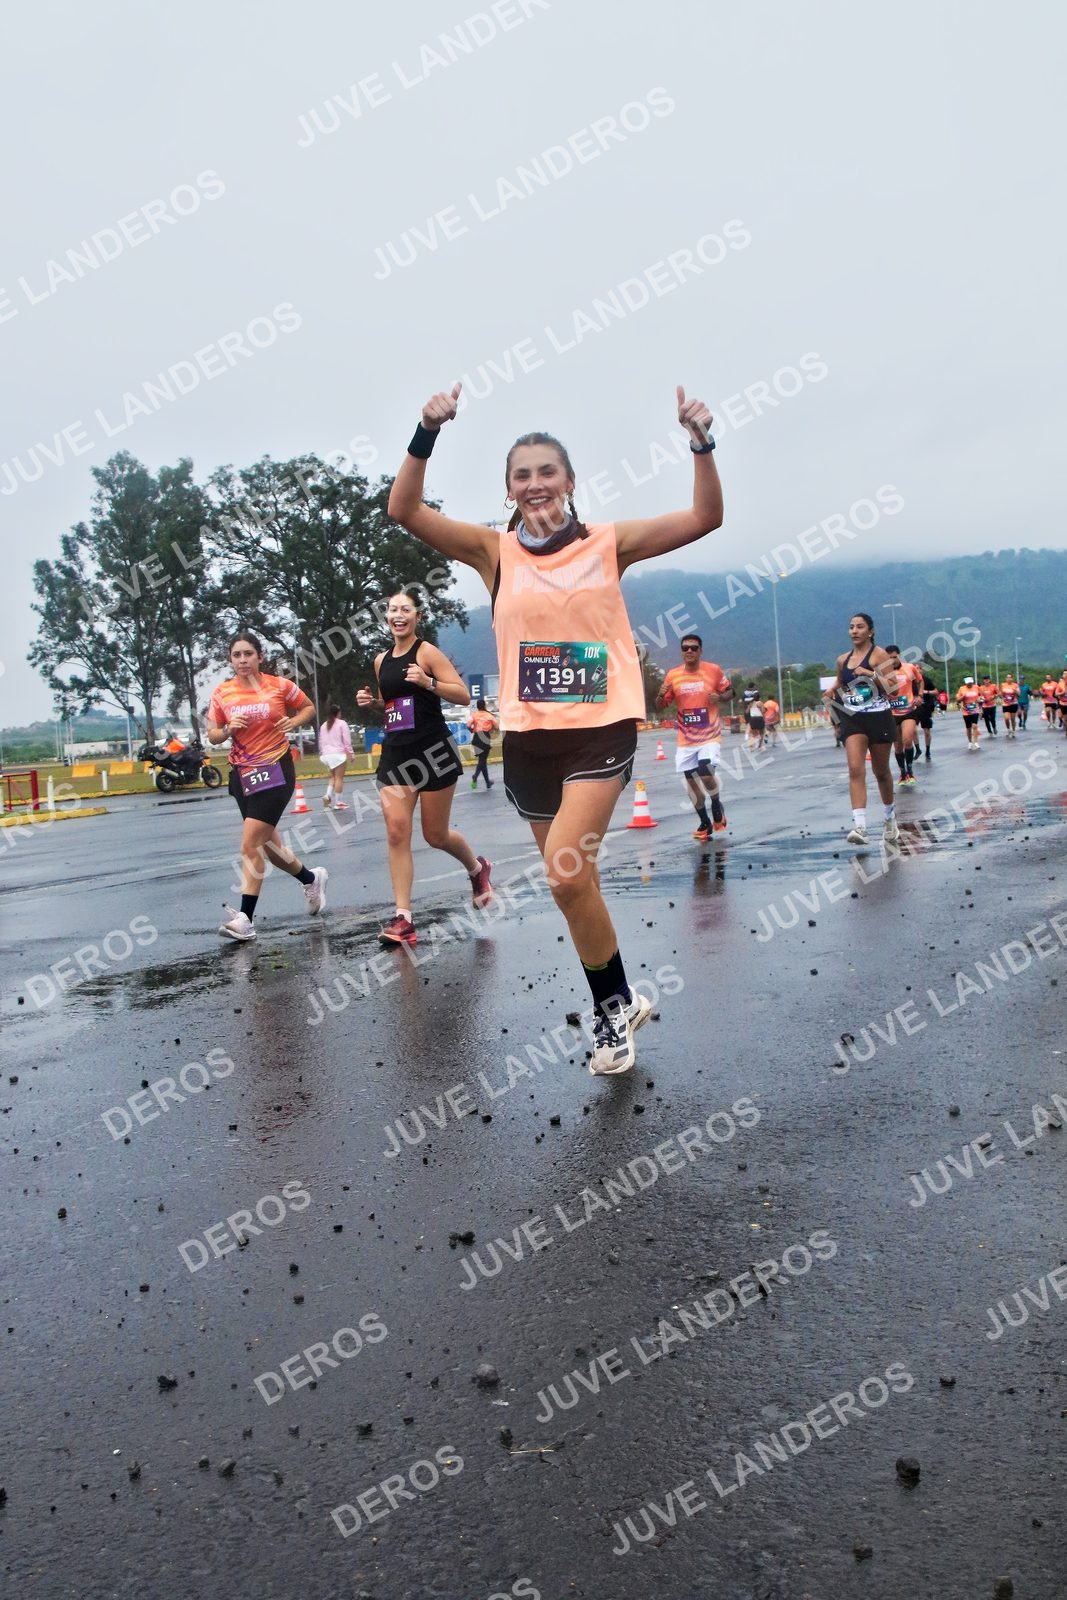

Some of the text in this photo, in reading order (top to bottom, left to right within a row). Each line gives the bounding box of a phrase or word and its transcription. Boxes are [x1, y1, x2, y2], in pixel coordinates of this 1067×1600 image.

[524, 646, 561, 657] CARRERA
[584, 646, 601, 659] 10K
[524, 656, 552, 664] OMNILIFE
[536, 667, 586, 685] 1391
[472, 685, 480, 696] E
[388, 711, 402, 723] 274
[250, 771, 270, 785] 512
